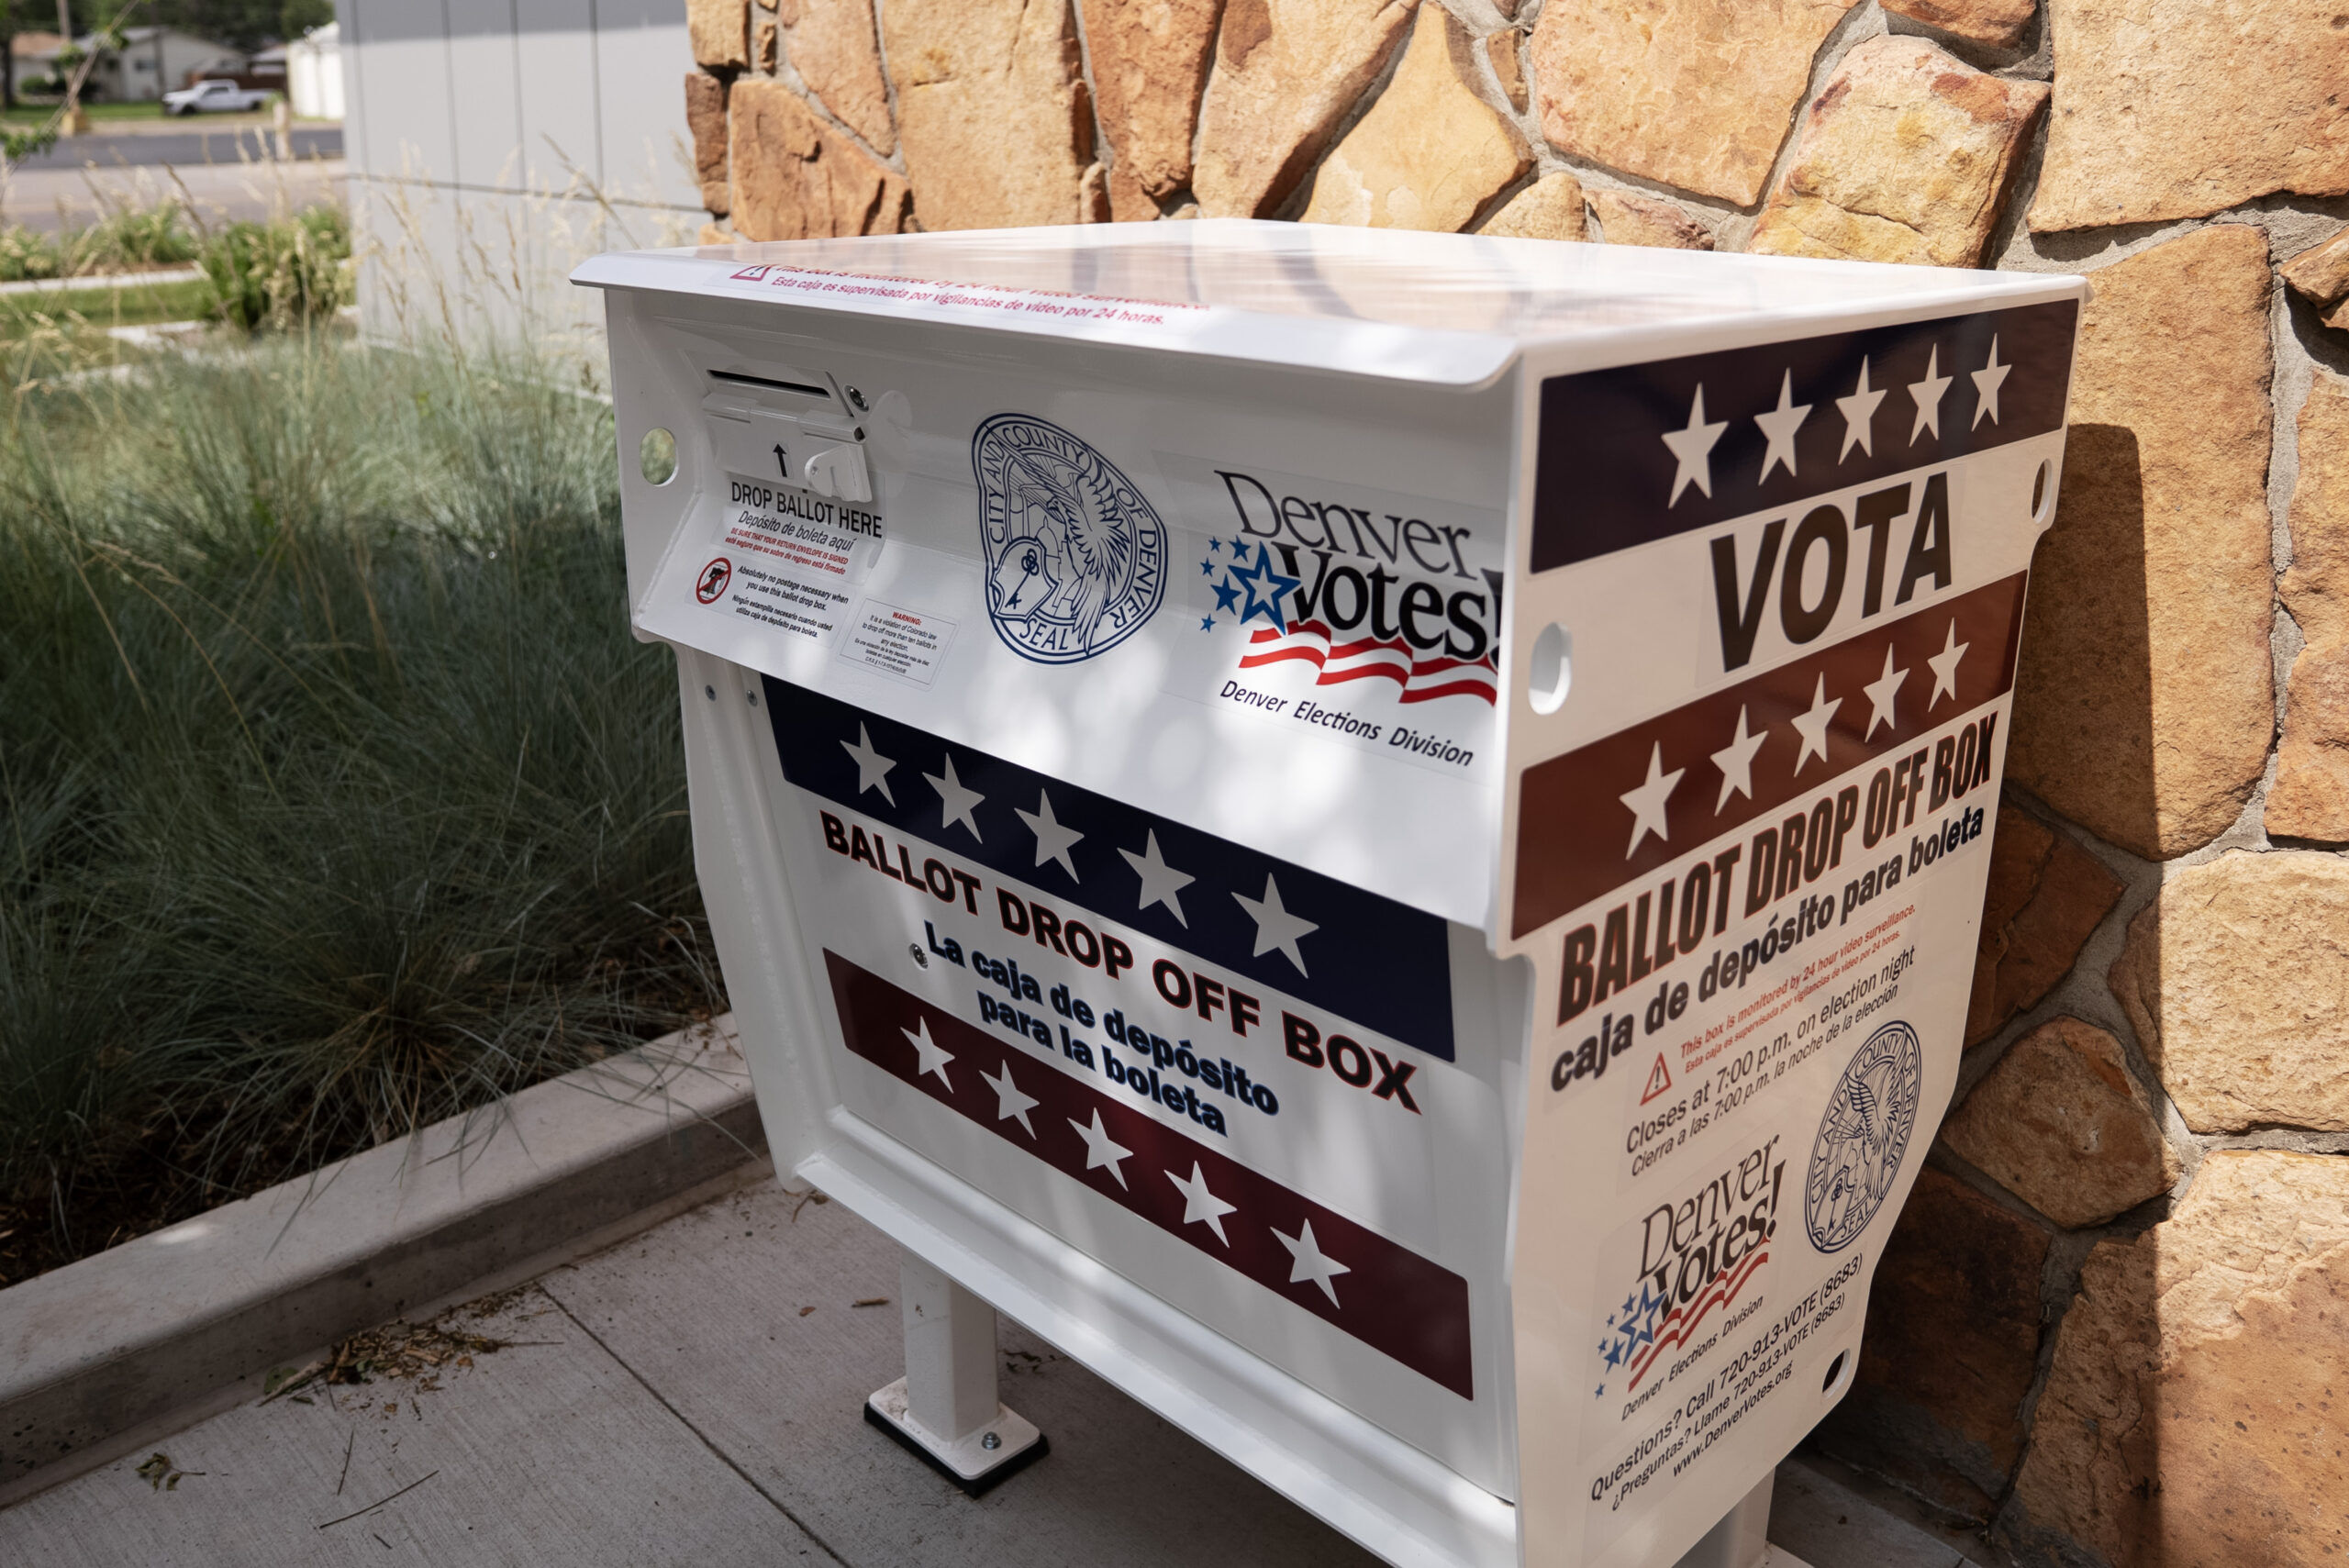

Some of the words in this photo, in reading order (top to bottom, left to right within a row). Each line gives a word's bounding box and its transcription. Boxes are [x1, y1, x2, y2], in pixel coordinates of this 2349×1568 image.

[773, 277, 797, 286] Esta
[797, 281, 822, 291] caja
[838, 285, 908, 298] supervisada
[907, 293, 933, 301] por
[934, 294, 1003, 307] vigilancias
[1005, 300, 1023, 310] de
[1026, 303, 1064, 314] video
[1063, 307, 1093, 317] por
[1093, 308, 1118, 318] 24
[1119, 311, 1163, 324] horas.
[984, 439, 1005, 482] AND
[1002, 426, 1085, 463] COUNTY
[732, 482, 772, 508] DROP
[777, 493, 833, 524] BALLOT
[840, 507, 881, 538] HERE
[740, 511, 780, 531] Depósito
[782, 522, 795, 535] de
[796, 525, 828, 544] boleta
[829, 538, 857, 551] aquí
[988, 487, 1006, 544] CITY
[1117, 488, 1148, 520] OF
[1214, 470, 1478, 581] Denver
[738, 566, 768, 582] Absolutely
[775, 579, 800, 590] postage
[800, 585, 831, 600] necessary
[832, 594, 848, 604] when
[751, 533, 763, 541] THAT
[763, 536, 777, 545] YOUR
[776, 539, 796, 550] RETURN
[796, 545, 822, 557] ENVELOPE
[829, 554, 848, 564] SIGNED
[1109, 528, 1157, 629] DENVER
[1709, 472, 1953, 673] VOTA
[732, 595, 749, 605] Ningún
[750, 602, 774, 613] estampilla
[774, 609, 797, 620] necesario
[798, 617, 817, 626] cuando
[818, 623, 833, 631] usted
[770, 587, 781, 596] this
[782, 591, 798, 602] ballot
[799, 596, 813, 607] drop
[814, 600, 826, 610] box.
[883, 619, 901, 629] violation
[907, 626, 929, 638] Colorado
[892, 611, 922, 626] WARNING:
[1019, 617, 1068, 650] SEAL
[1271, 541, 1504, 668] Votes!
[1220, 680, 1287, 713] Denver
[1293, 701, 1382, 740] Elections
[1388, 727, 1474, 767] Division
[1556, 844, 1742, 1029] BALLOT
[1743, 784, 1860, 919] DROP
[1863, 746, 1930, 850] OFF
[1928, 710, 1998, 817] BOX
[819, 809, 982, 916] BALLOT
[996, 887, 1133, 980] DROP
[1152, 958, 1260, 1038] OFF
[1281, 1010, 1422, 1116] BOX
[1552, 1013, 1634, 1092] caja
[1644, 981, 1688, 1036] de
[1698, 890, 1835, 1002] depósito
[1841, 855, 1902, 925] para
[1908, 806, 1985, 879] boleta
[1683, 1037, 1702, 1058] This
[1705, 1023, 1723, 1042] box
[1727, 1016, 1735, 1029] is
[1739, 980, 1787, 1022] monitored
[1790, 974, 1801, 989] by
[1803, 962, 1815, 981] 24
[1818, 951, 1838, 972] hour
[1841, 937, 1863, 961] video
[1865, 906, 1915, 943] surveillance.
[923, 919, 966, 967] La
[971, 951, 1042, 1005] caja
[1051, 980, 1096, 1028] de
[1103, 1007, 1279, 1117] depósito
[1686, 1056, 1703, 1073] Esta
[1706, 1044, 1721, 1060] caja
[1724, 1037, 1733, 1048] es
[1735, 1007, 1778, 1041] supervisada
[1780, 998, 1793, 1014] por
[1795, 975, 1830, 1002] vigilancias
[1831, 968, 1840, 979] de
[1842, 957, 1859, 973] video
[1860, 949, 1871, 963] por
[1872, 940, 1880, 953] 24
[1882, 931, 1899, 947] horas.
[977, 990, 1053, 1050] para
[1061, 1025, 1096, 1072] la
[1102, 1044, 1228, 1138] boleta
[1628, 1101, 1687, 1152] Closes
[1692, 1081, 1710, 1110] at
[1718, 1051, 1753, 1093] 7:00
[1758, 1033, 1791, 1072] p.m.
[1798, 1014, 1816, 1039] on
[1821, 974, 1876, 1023] election
[1881, 946, 1914, 984] night
[1632, 1138, 1674, 1176] Cierra
[1677, 1129, 1687, 1145] a
[1690, 1113, 1709, 1137] las
[1715, 1087, 1742, 1119] 7:00
[1743, 1073, 1769, 1104] p.m.
[1775, 1062, 1786, 1079] la
[1788, 1036, 1822, 1069] noche
[1826, 1024, 1840, 1043] de
[1842, 1016, 1853, 1032] la
[1855, 985, 1898, 1022] elección
[1854, 1033, 1901, 1078] COUNTY
[1904, 1051, 1916, 1077] OF
[1822, 1088, 1848, 1144] AND
[1887, 1084, 1916, 1169] DENVER
[1637, 1134, 1780, 1283] Denver
[1811, 1155, 1826, 1204] CITY
[1841, 1202, 1871, 1238] SEAL
[1654, 1159, 1787, 1322] Votes!
[1591, 1410, 1682, 1501] Questions?
[1687, 1373, 1715, 1418] Call
[1720, 1293, 1817, 1389] 720-913-VOTE
[1820, 1253, 1863, 1306] (8683)
[1621, 1374, 1664, 1420] Denver
[1669, 1335, 1717, 1382] Elections
[1722, 1296, 1763, 1338] Division
[1612, 1428, 1690, 1510] ¿Preguntas?
[1694, 1394, 1730, 1435] Llame
[1733, 1323, 1809, 1399] 720-913-VOTE
[1810, 1293, 1845, 1335] (8683)
[1673, 1361, 1792, 1477] www.DenverVotes.org
